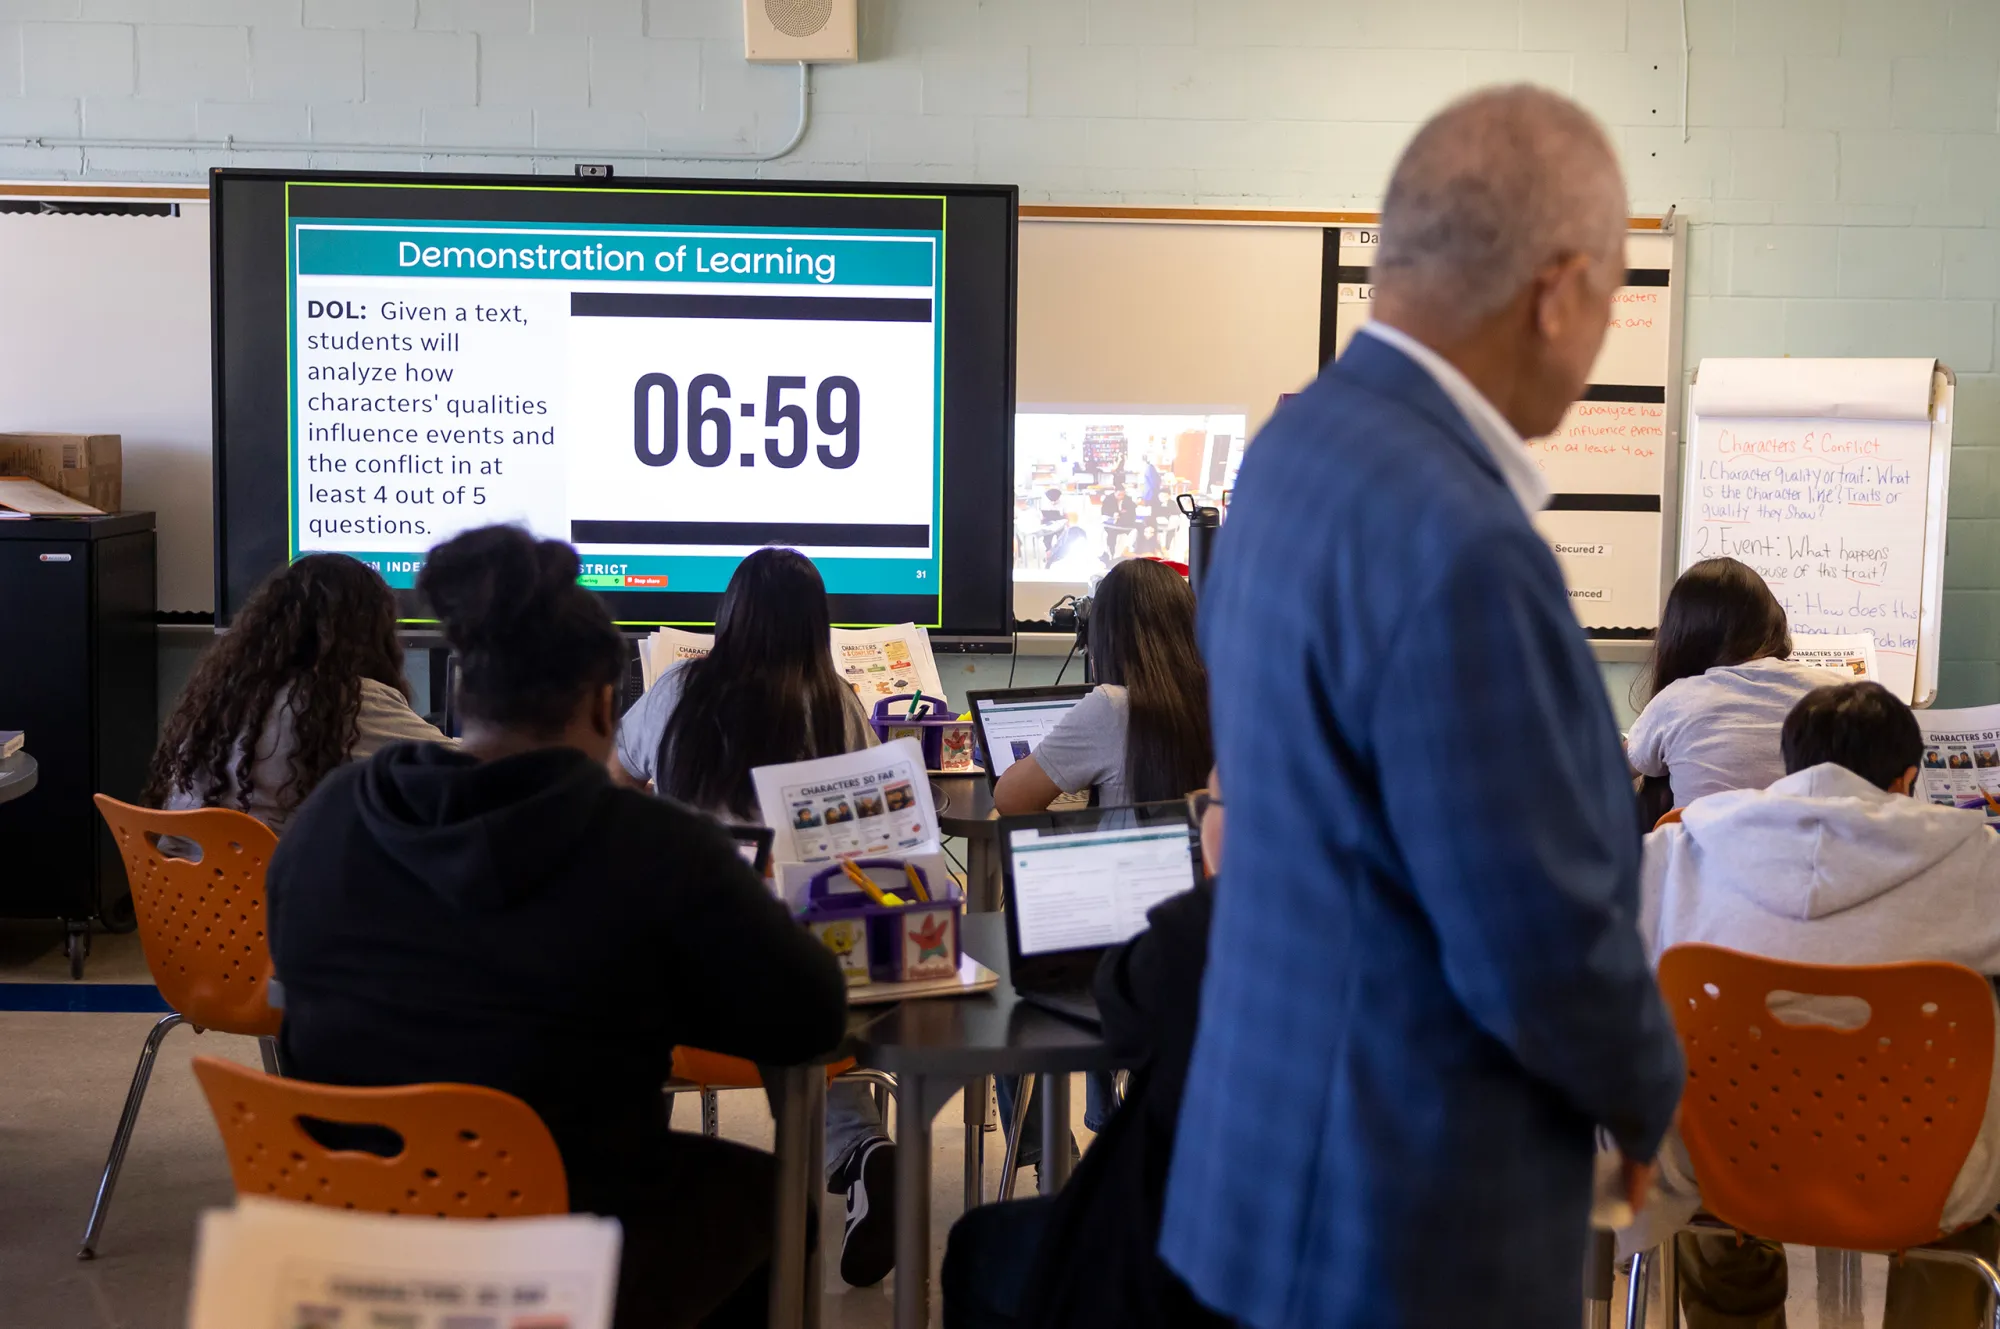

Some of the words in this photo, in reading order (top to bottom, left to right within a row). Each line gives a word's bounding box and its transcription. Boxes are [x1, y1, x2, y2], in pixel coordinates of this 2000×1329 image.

[1360, 231, 1379, 244] Da
[399, 241, 645, 272] Demonstration
[654, 244, 687, 273] of
[696, 246, 836, 284] Learning
[1610, 293, 1657, 303] aracters
[307, 300, 367, 320] DOL:
[380, 301, 447, 321] Given
[455, 306, 467, 322] a
[475, 304, 528, 326] text,
[1625, 318, 1653, 328] and
[307, 331, 413, 351] students
[420, 333, 460, 352] will
[307, 362, 398, 386] analyze
[405, 363, 454, 382] how
[308, 392, 439, 413] characters'
[446, 395, 547, 418] qualities
[1578, 405, 1636, 421] analyze
[634, 372, 860, 470] 06:59
[1569, 425, 1627, 438] influence
[308, 422, 418, 443] influence
[426, 426, 504, 445] events
[512, 426, 555, 446] and
[1718, 428, 1796, 454] Characters
[1821, 433, 1881, 455] Conflict
[1543, 442, 1559, 452] in
[1564, 443, 1579, 453] at
[1584, 444, 1617, 454] least
[1621, 446, 1631, 456] 4
[1634, 448, 1655, 458] out
[308, 454, 347, 473] the
[355, 454, 443, 474] conflict
[451, 455, 472, 475] in
[480, 457, 503, 475] at
[1709, 460, 1772, 481] Character
[1774, 465, 1821, 488] quality
[1823, 471, 1836, 483] or
[1876, 464, 1911, 486] What
[309, 484, 366, 503] least
[373, 485, 388, 504] 4
[395, 487, 435, 505] out
[442, 486, 466, 505] of
[472, 486, 486, 505] 5
[1721, 486, 1741, 500] the
[1844, 487, 1881, 502] Traits
[1886, 491, 1904, 504] or
[1702, 504, 1750, 520] quality
[1756, 504, 1783, 523] they
[309, 515, 432, 538] questions.
[1555, 544, 1595, 554] Secured
[1598, 545, 1604, 554] 2
[1720, 527, 1781, 556] Event:
[1787, 535, 1831, 560] What
[1839, 537, 1889, 562] happens
[386, 561, 427, 573] INDE
[916, 570, 927, 579] 31
[1755, 564, 1788, 579] cause
[1793, 563, 1810, 578] of
[1817, 562, 1837, 578] this
[1841, 562, 1889, 583] trait?
[1565, 589, 1603, 598] vanced
[1805, 591, 1844, 616] How
[1848, 590, 1887, 618] does
[1892, 599, 1918, 619] this
[679, 646, 710, 655] CHARACT
[1930, 732, 1980, 742] CHARACTERS
[1982, 731, 1994, 740] SO
[801, 778, 860, 796] CHARACTERS
[863, 776, 876, 786] SO
[878, 770, 895, 781] FAR
